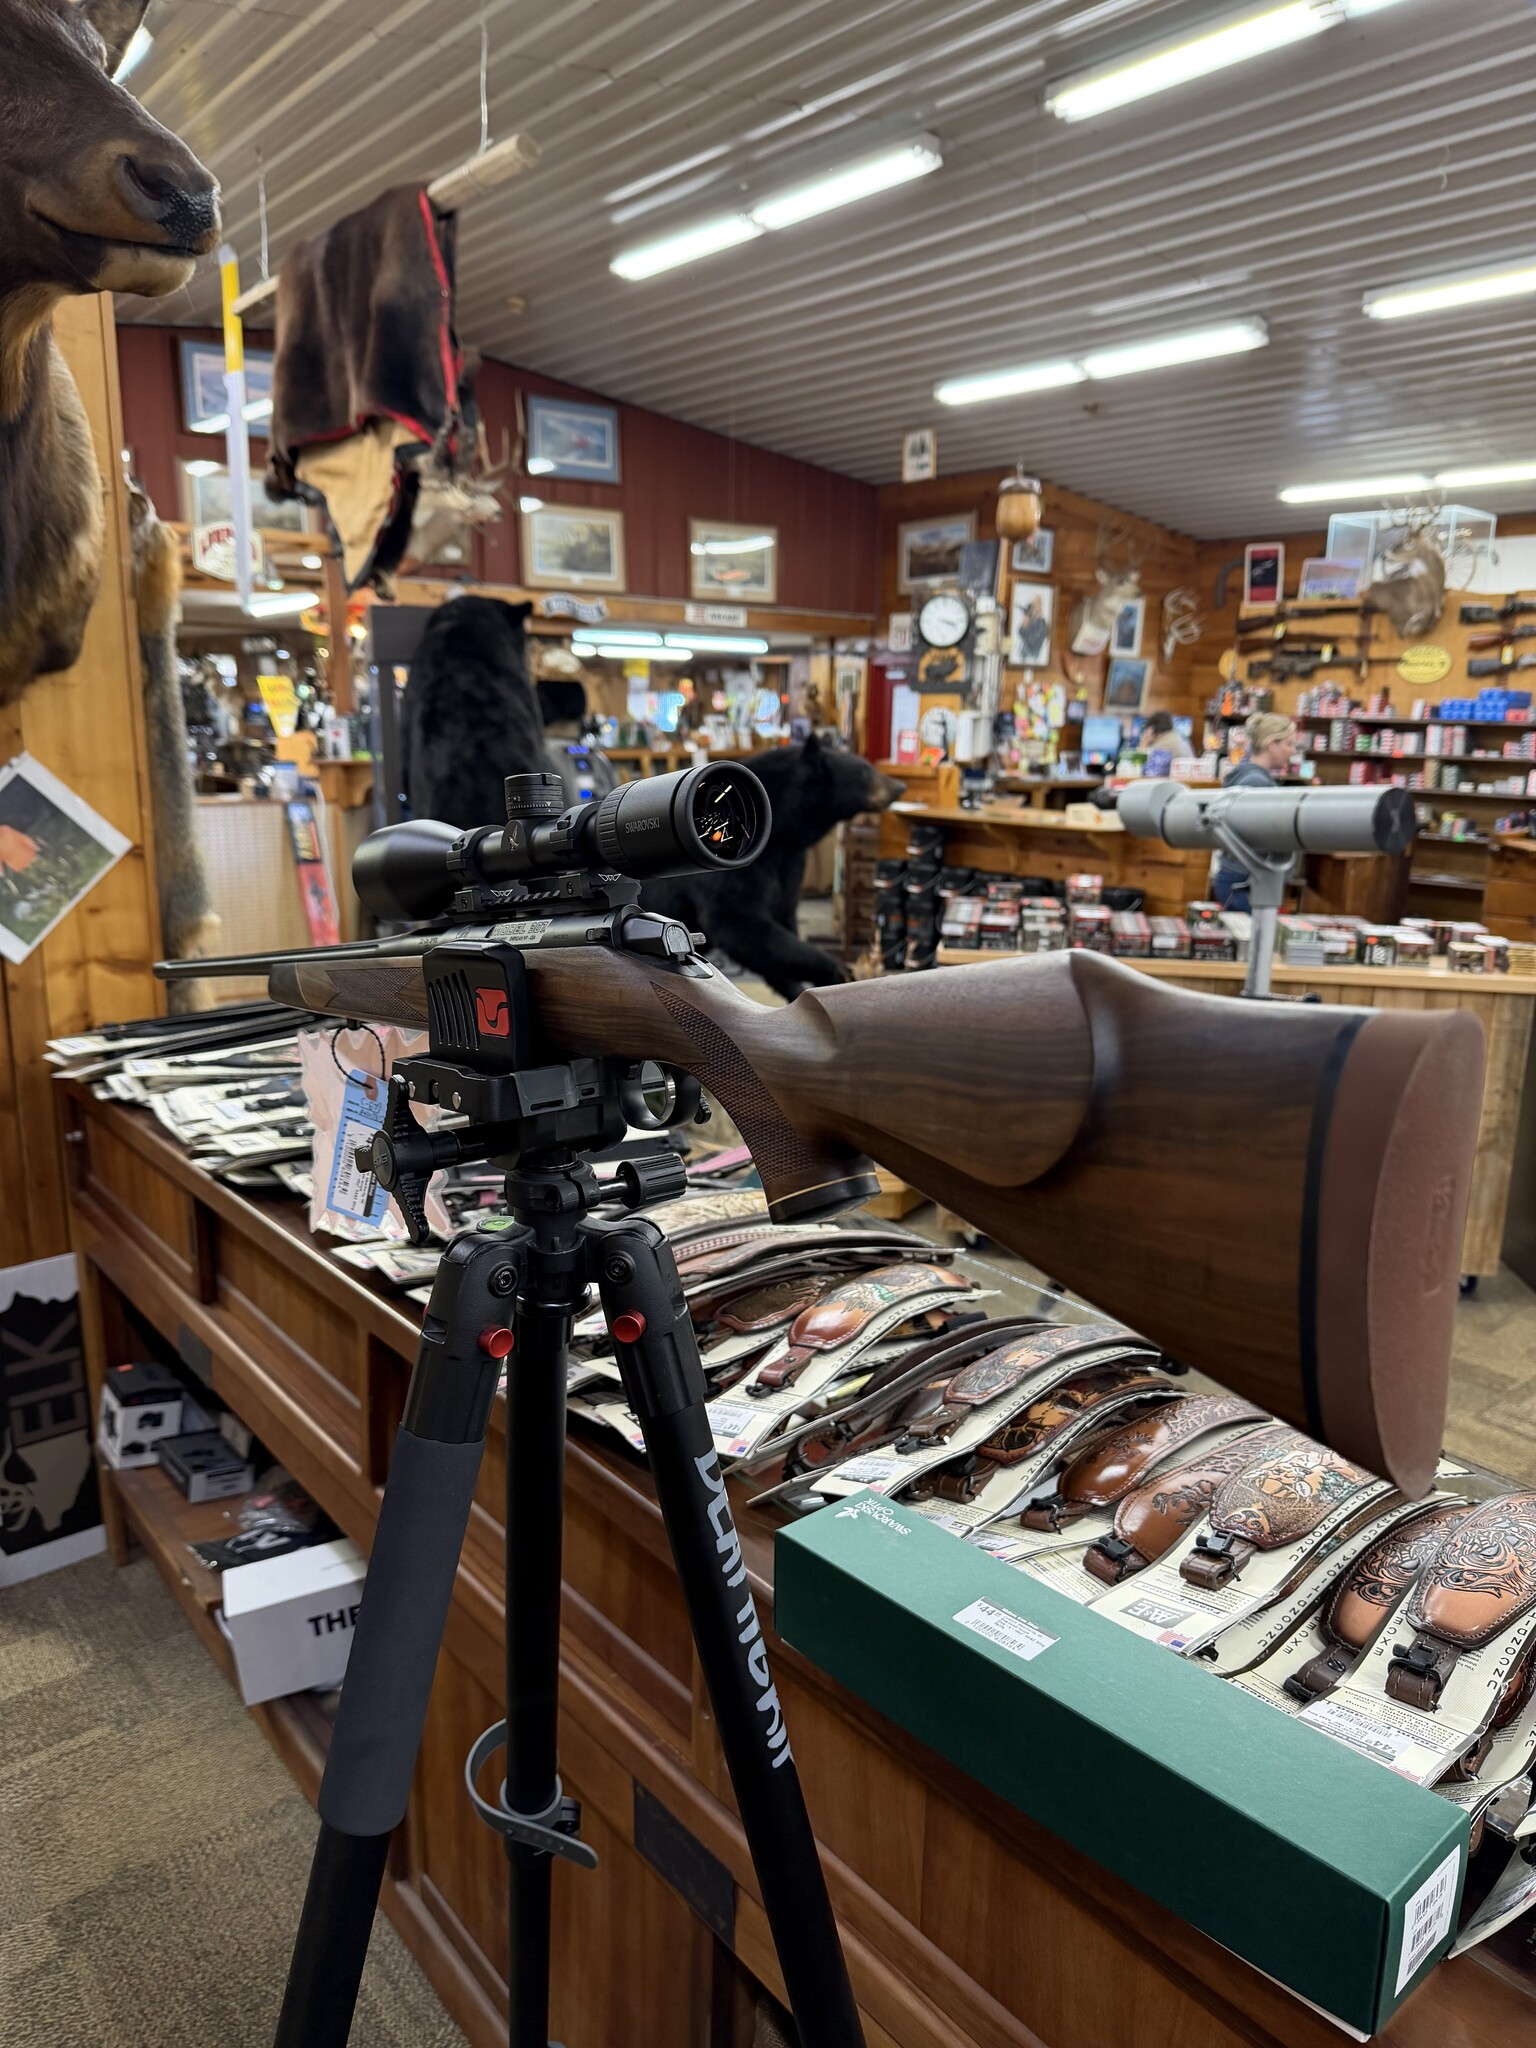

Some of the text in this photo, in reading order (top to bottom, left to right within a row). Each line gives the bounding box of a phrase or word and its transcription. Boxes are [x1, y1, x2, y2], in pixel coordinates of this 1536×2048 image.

[625, 816, 660, 834] SWAROVSKI
[0, 1306, 91, 1448] ELK
[854, 1502, 912, 1535] SWAROVSKI
[863, 1497, 894, 1515] OPTIK
[1288, 1483, 1385, 1562] UNCONDITIONAL
[1257, 1547, 1358, 1647] UNCONDITIONAL
[308, 1605, 358, 1638] THE
